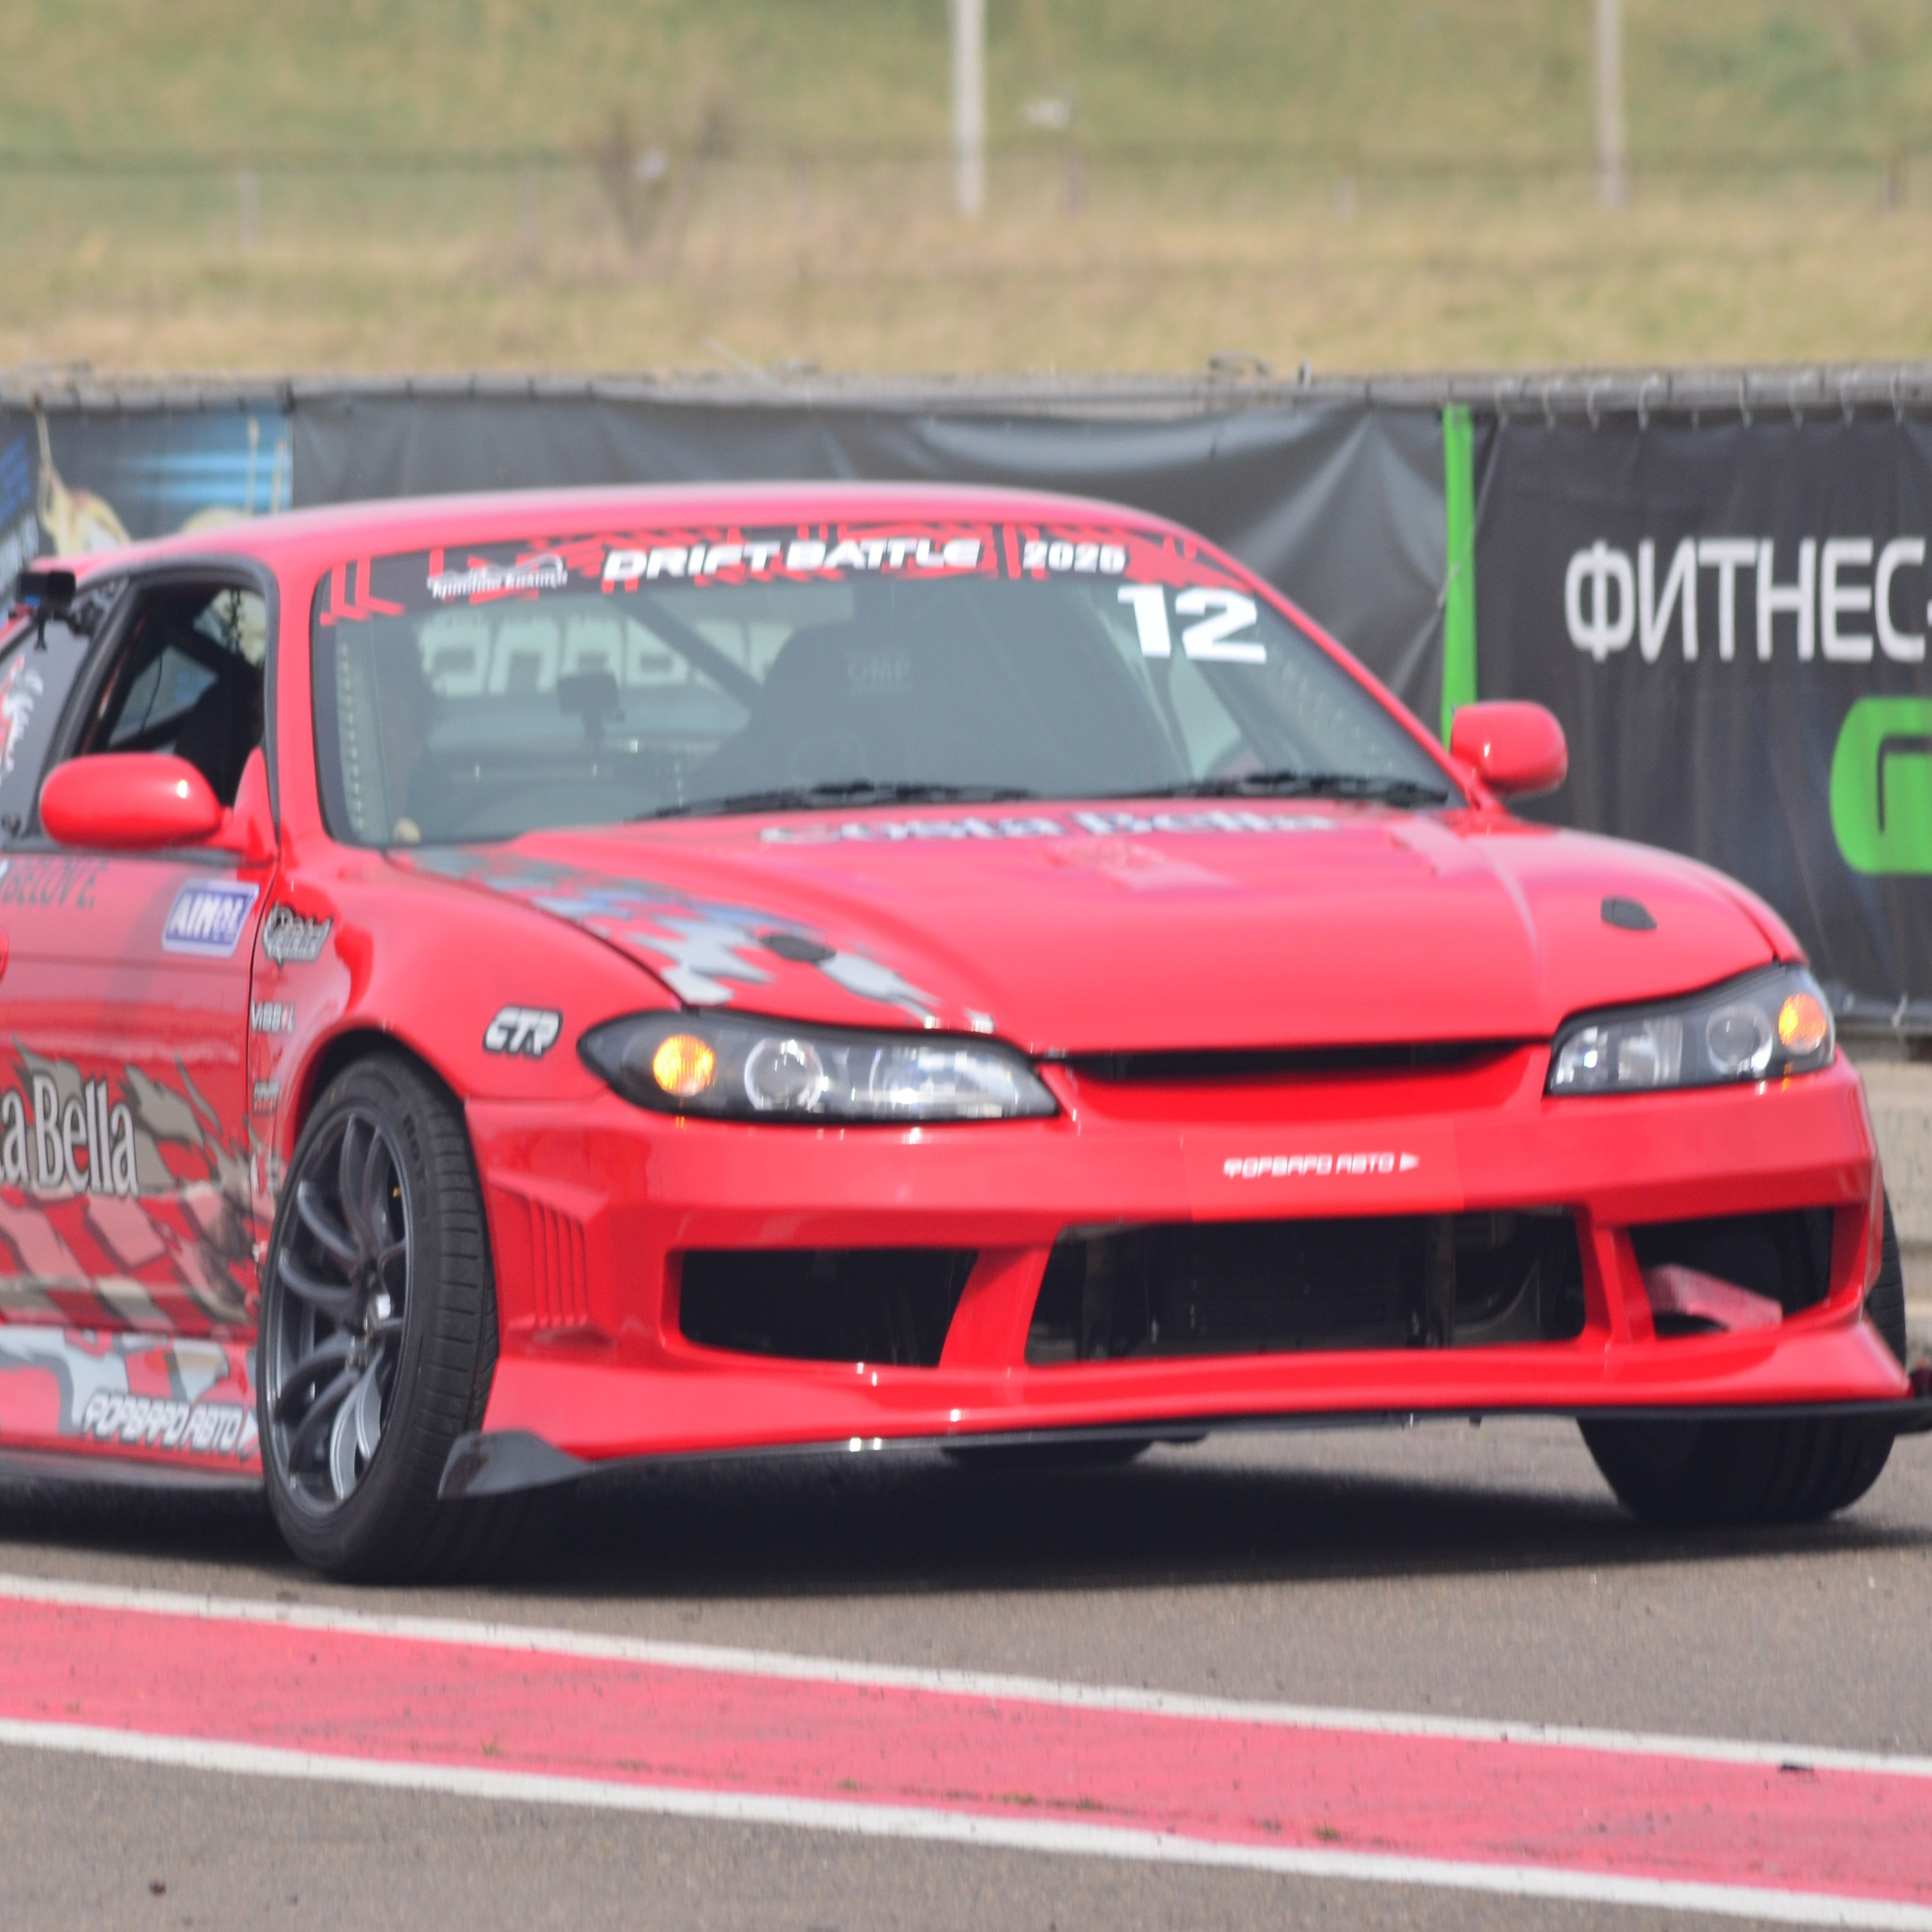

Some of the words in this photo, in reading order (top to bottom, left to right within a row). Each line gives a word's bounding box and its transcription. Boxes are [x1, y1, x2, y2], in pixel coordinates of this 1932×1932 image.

[605, 541, 782, 581] DRIFT
[786, 538, 980, 571] BATTLE
[1023, 540, 1126, 575] 2020
[1564, 537, 1932, 663] ФИТНЕС
[1117, 584, 1267, 664] 12
[33, 1074, 141, 1198] Bella
